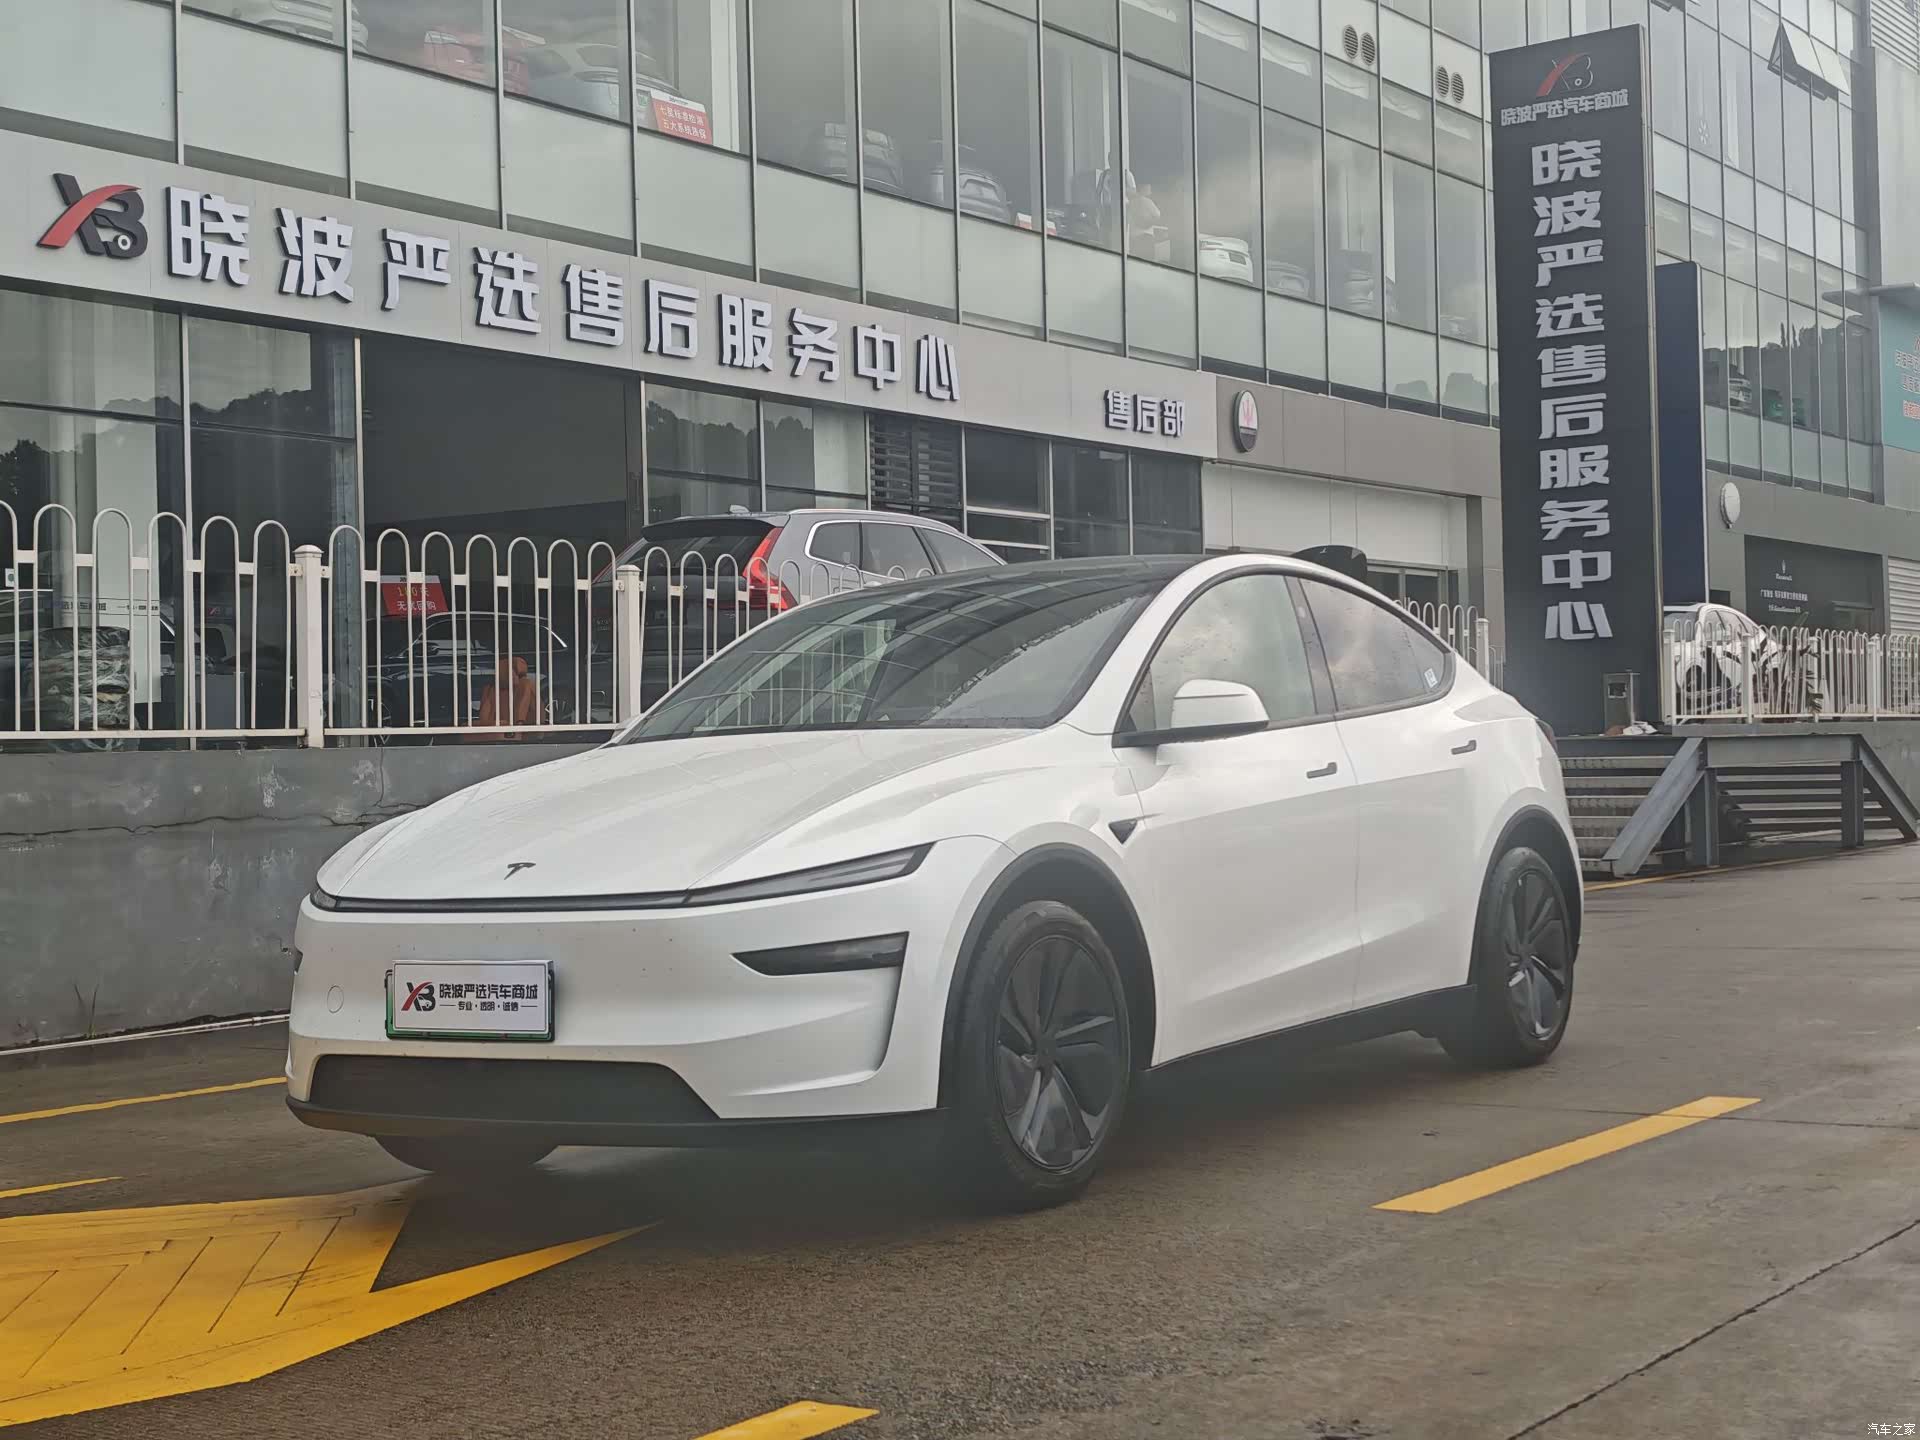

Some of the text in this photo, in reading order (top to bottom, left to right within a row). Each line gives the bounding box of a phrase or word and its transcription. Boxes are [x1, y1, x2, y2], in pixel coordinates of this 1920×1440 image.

[1501, 88, 1629, 126] 晓波严选汽车商城
[165, 185, 961, 402] 晓波严选售后服务中心
[1104, 388, 1186, 437] 售后部
[1531, 138, 1613, 641] 晓波严选售后服务中心
[439, 983, 539, 1000] 晓波严选汽车商城
